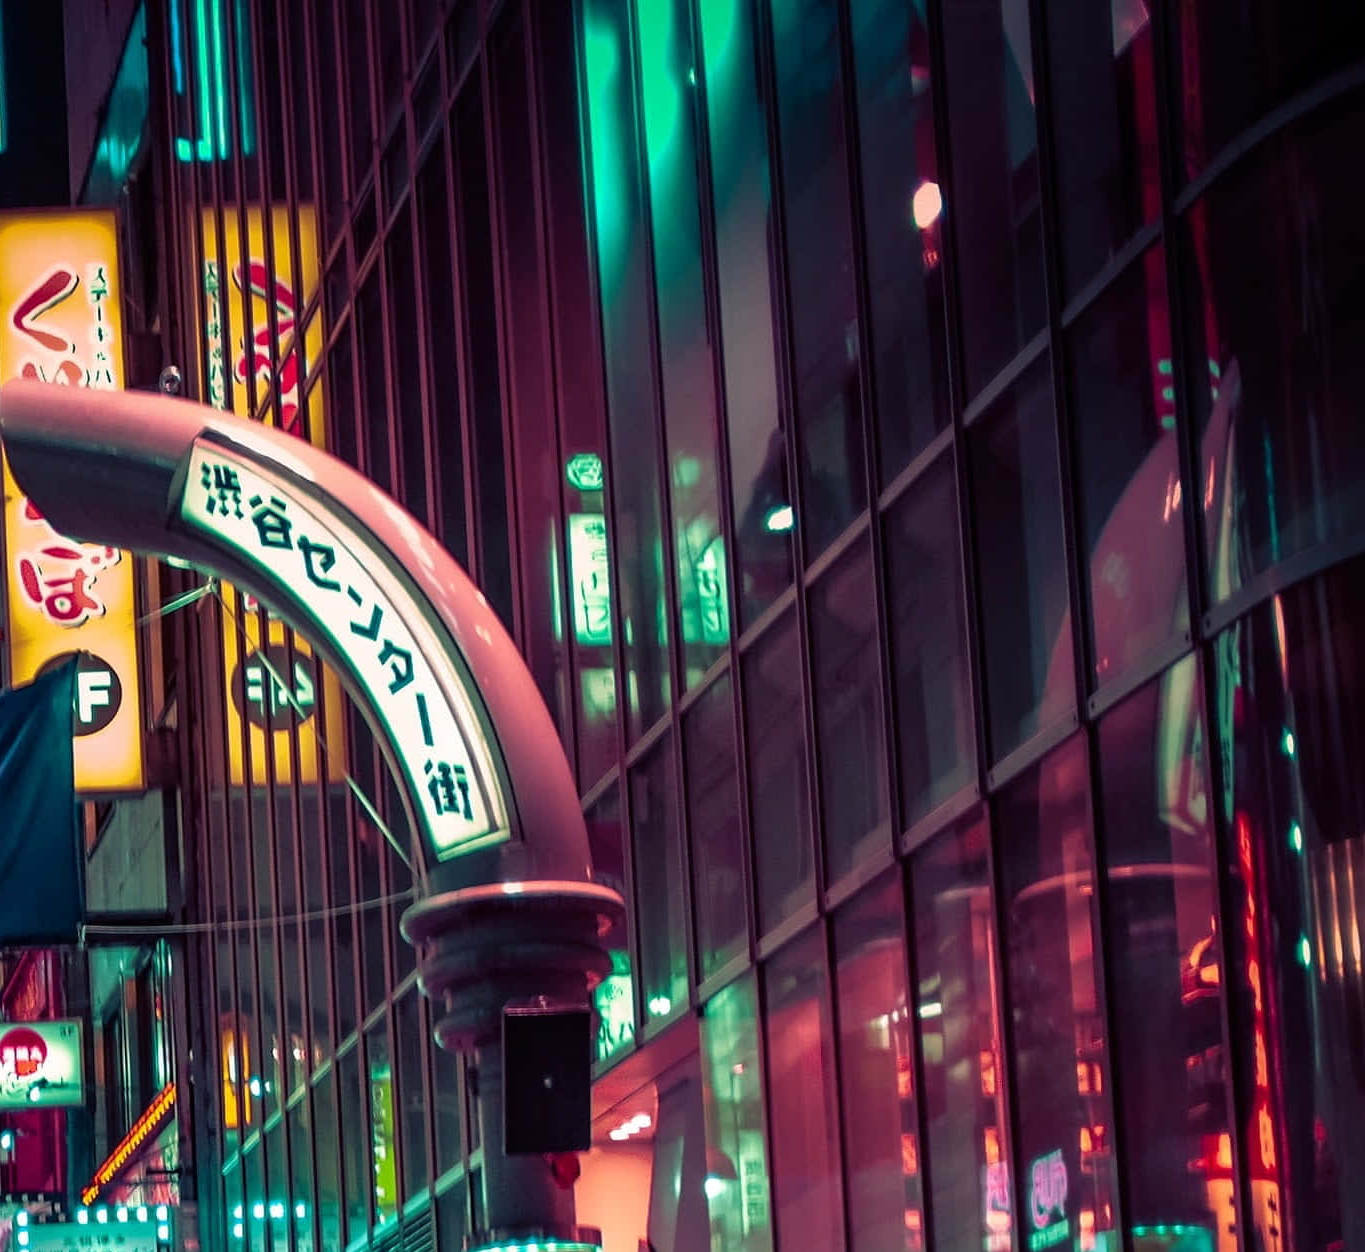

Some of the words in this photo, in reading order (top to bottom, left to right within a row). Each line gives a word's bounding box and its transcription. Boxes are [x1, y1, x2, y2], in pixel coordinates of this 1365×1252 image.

[198, 460, 475, 823] 渋谷センター街
